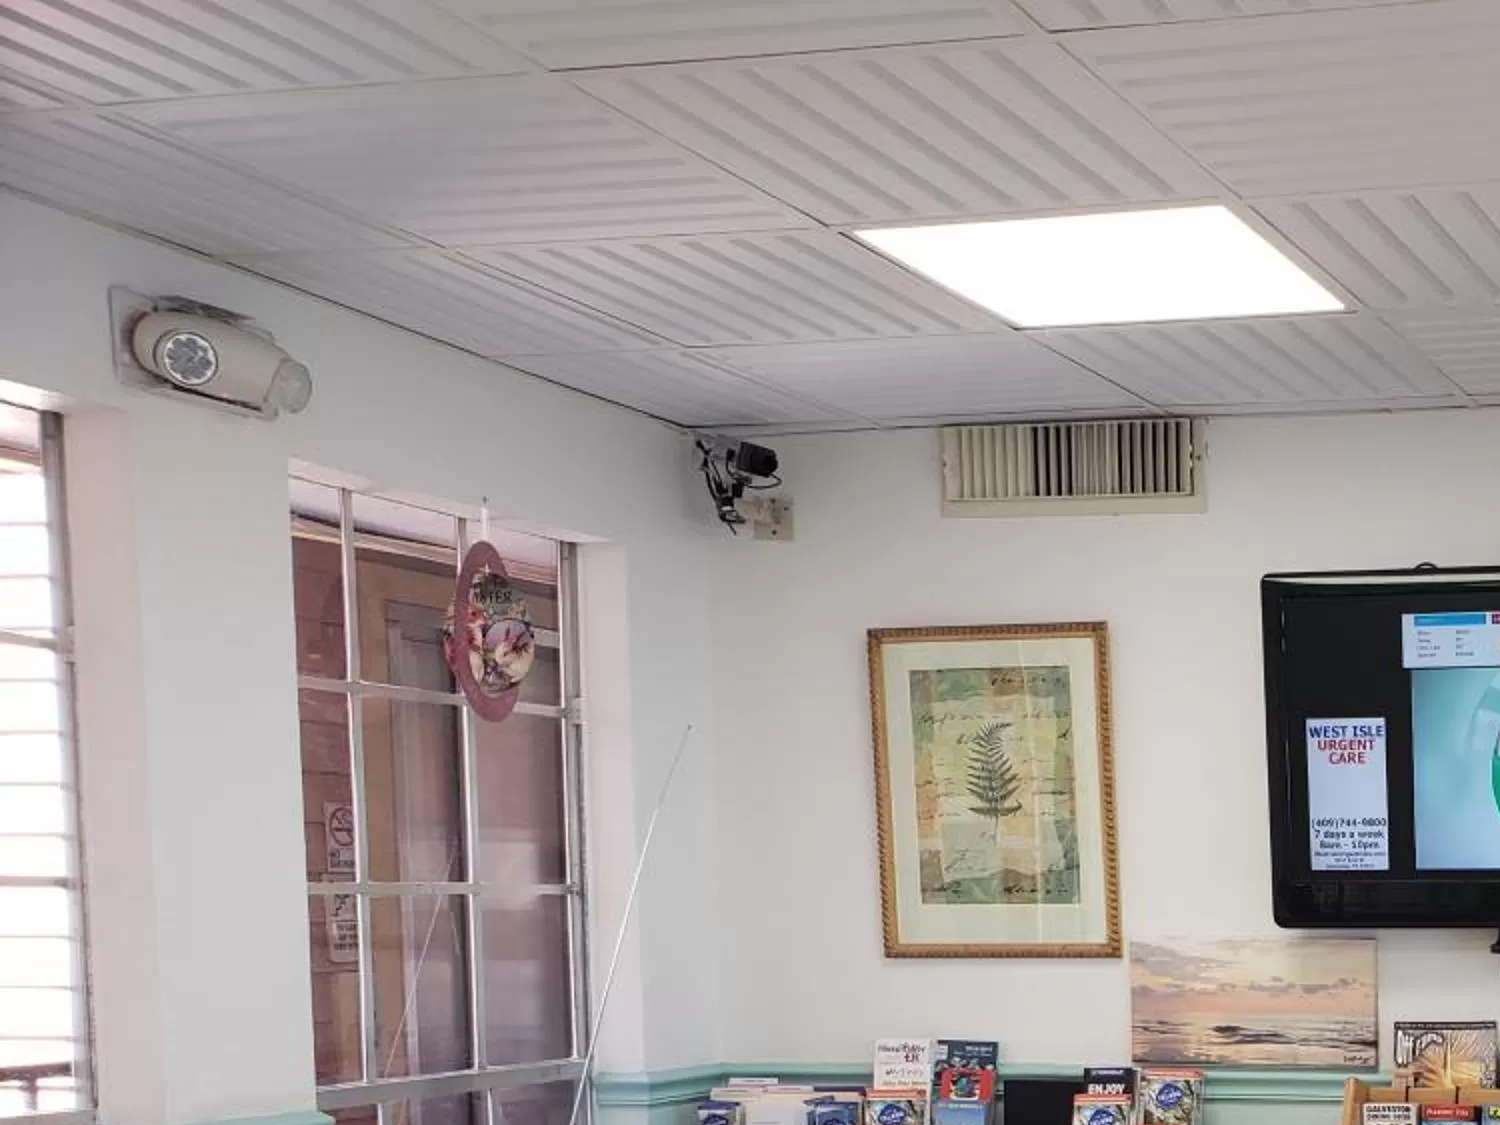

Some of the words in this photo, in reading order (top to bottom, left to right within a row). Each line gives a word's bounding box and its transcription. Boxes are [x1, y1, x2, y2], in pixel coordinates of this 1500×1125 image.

[1309, 725, 1348, 738] WEST
[1353, 725, 1385, 738] ISLE
[1317, 739, 1376, 751] URGENT
[1329, 752, 1365, 764] CARE
[1314, 830, 1321, 838] 7
[1323, 830, 1347, 841] days
[1087, 1083, 1125, 1094] ENJOY
